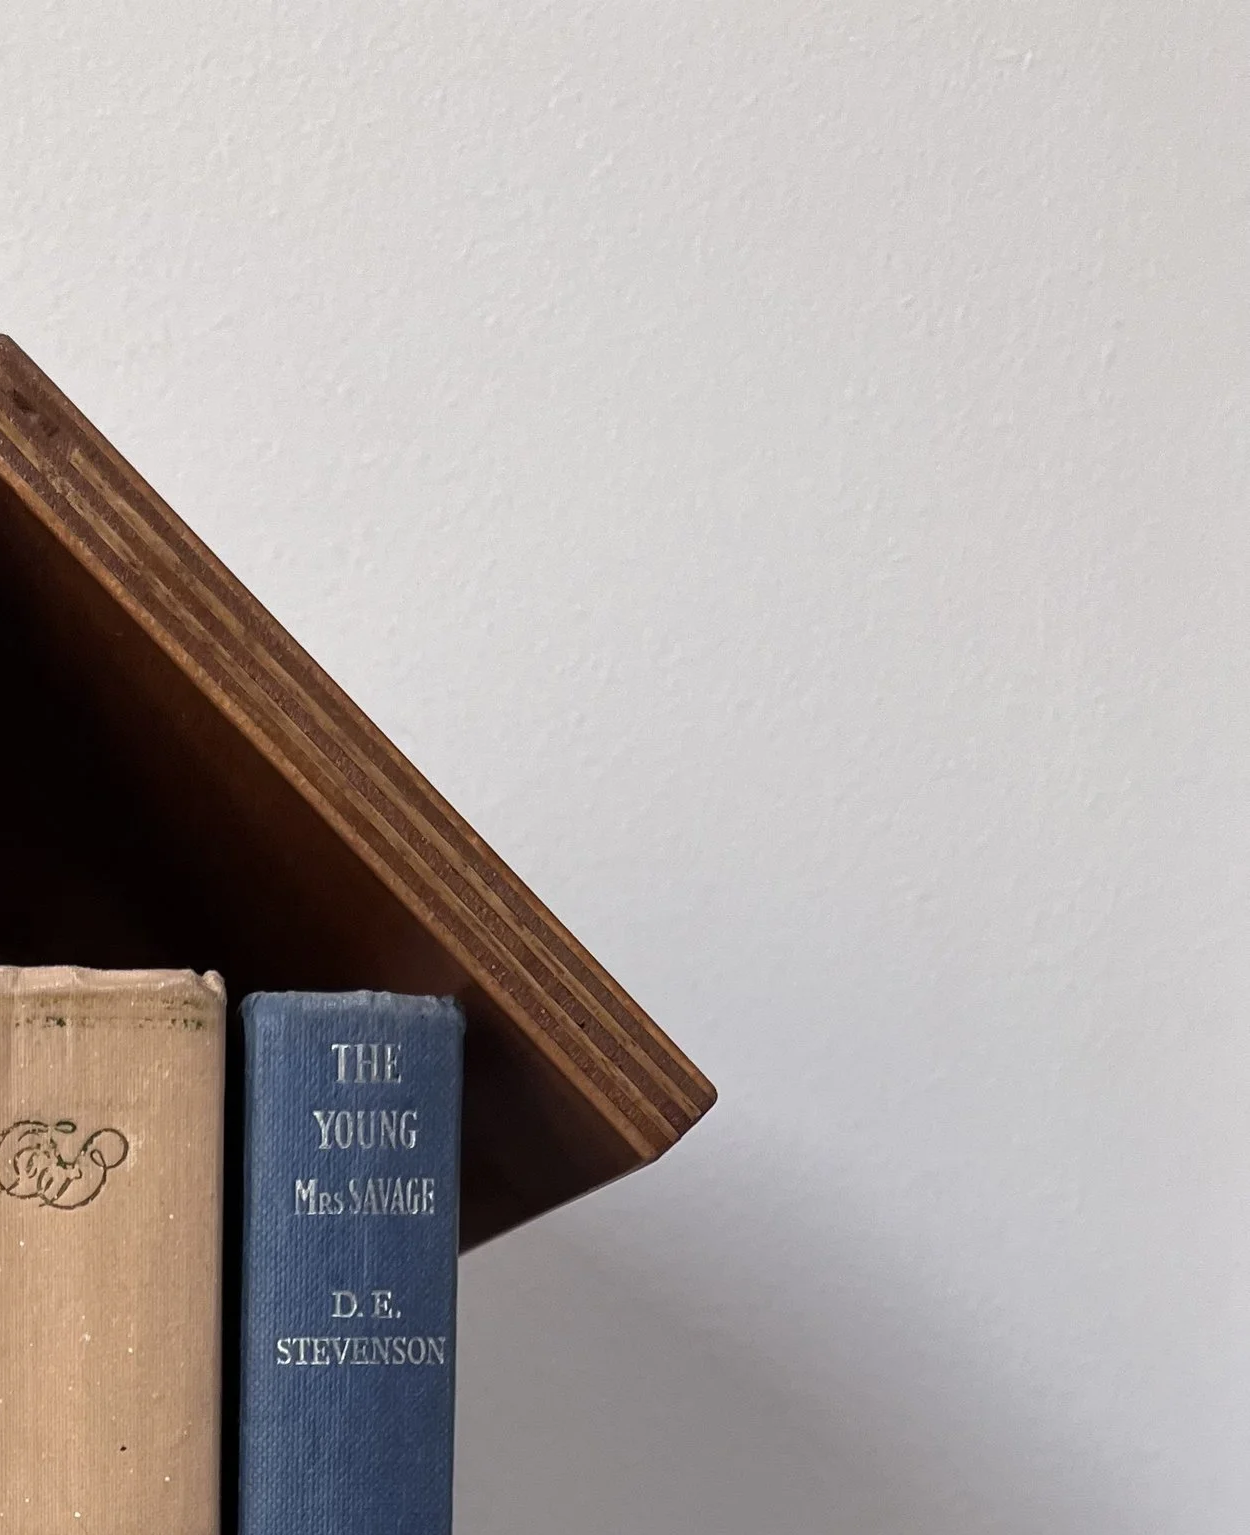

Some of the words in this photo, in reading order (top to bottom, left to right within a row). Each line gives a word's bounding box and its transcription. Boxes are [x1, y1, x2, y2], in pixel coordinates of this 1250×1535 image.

[331, 1043, 402, 1083] THE
[313, 1110, 418, 1150] YOUNG
[347, 1178, 435, 1216] SAVAGE
[331, 1290, 364, 1319] D.
[370, 1290, 402, 1319] E.
[276, 1336, 446, 1365] STEVENSON
